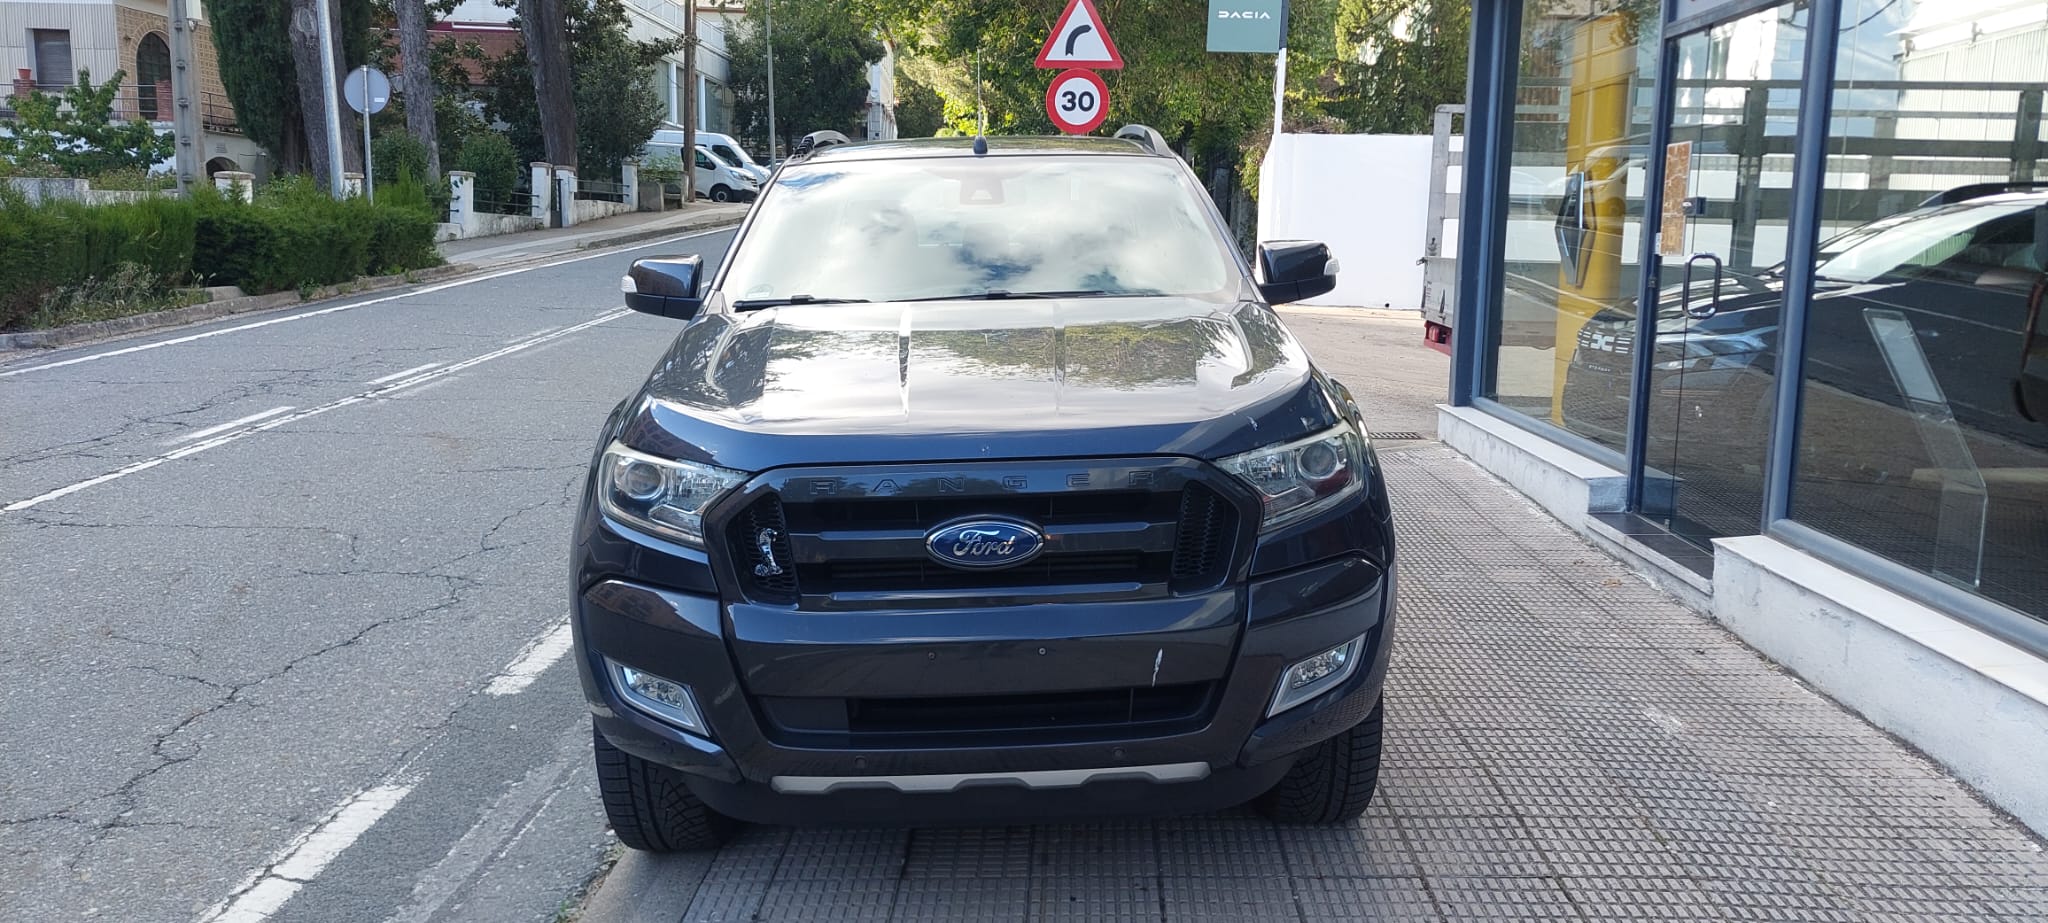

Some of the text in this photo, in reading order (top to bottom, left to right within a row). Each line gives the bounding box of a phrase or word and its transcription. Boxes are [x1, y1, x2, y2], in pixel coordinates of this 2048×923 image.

[1218, 10, 1271, 19] DACIA
[1061, 90, 1095, 112] 30
[809, 470, 1154, 495] RANGER
[953, 529, 1015, 556] Ford
